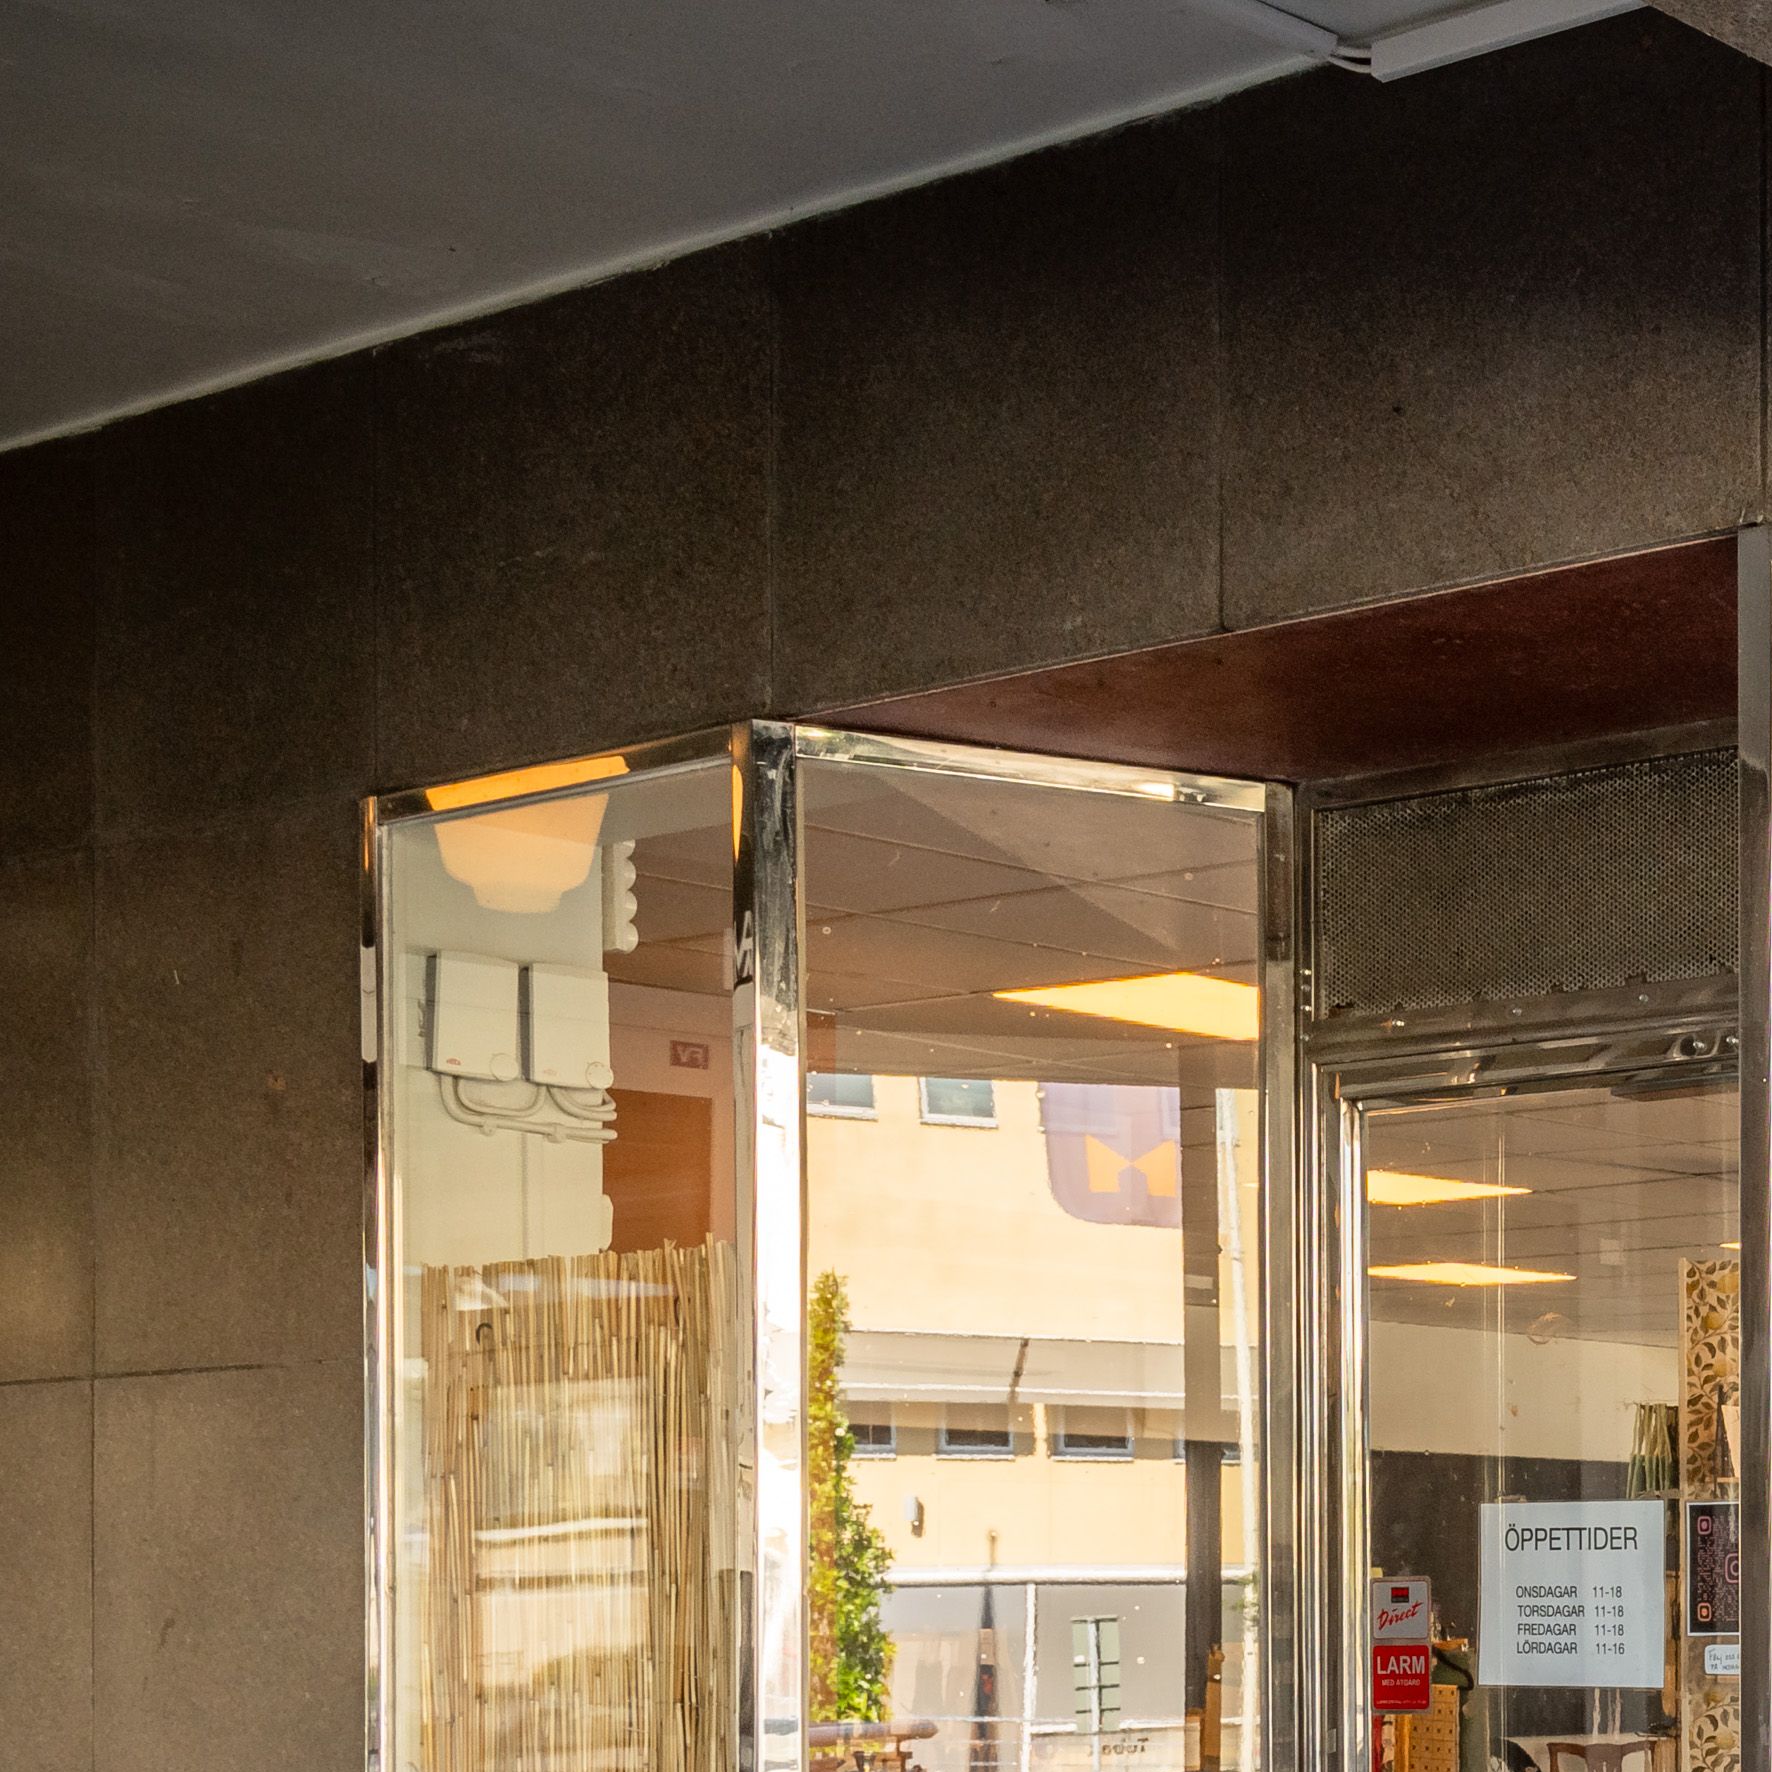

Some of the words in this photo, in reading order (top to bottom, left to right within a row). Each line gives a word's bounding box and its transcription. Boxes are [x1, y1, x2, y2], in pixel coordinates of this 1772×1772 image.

[1504, 1523, 1638, 1551] ÖPPETTIDER
[1515, 1585, 1578, 1599] ONSDAGAR
[1592, 1586, 1623, 1598] 11-18
[1517, 1605, 1585, 1618] TORSDAGAR
[1594, 1605, 1624, 1618] 11-18
[1517, 1623, 1577, 1636] FREDAGAR
[1594, 1624, 1624, 1637] 11-18
[1516, 1639, 1578, 1655] LÖRDAGAR
[1595, 1642, 1625, 1655] 11-16
[1376, 1655, 1426, 1675] LARM
